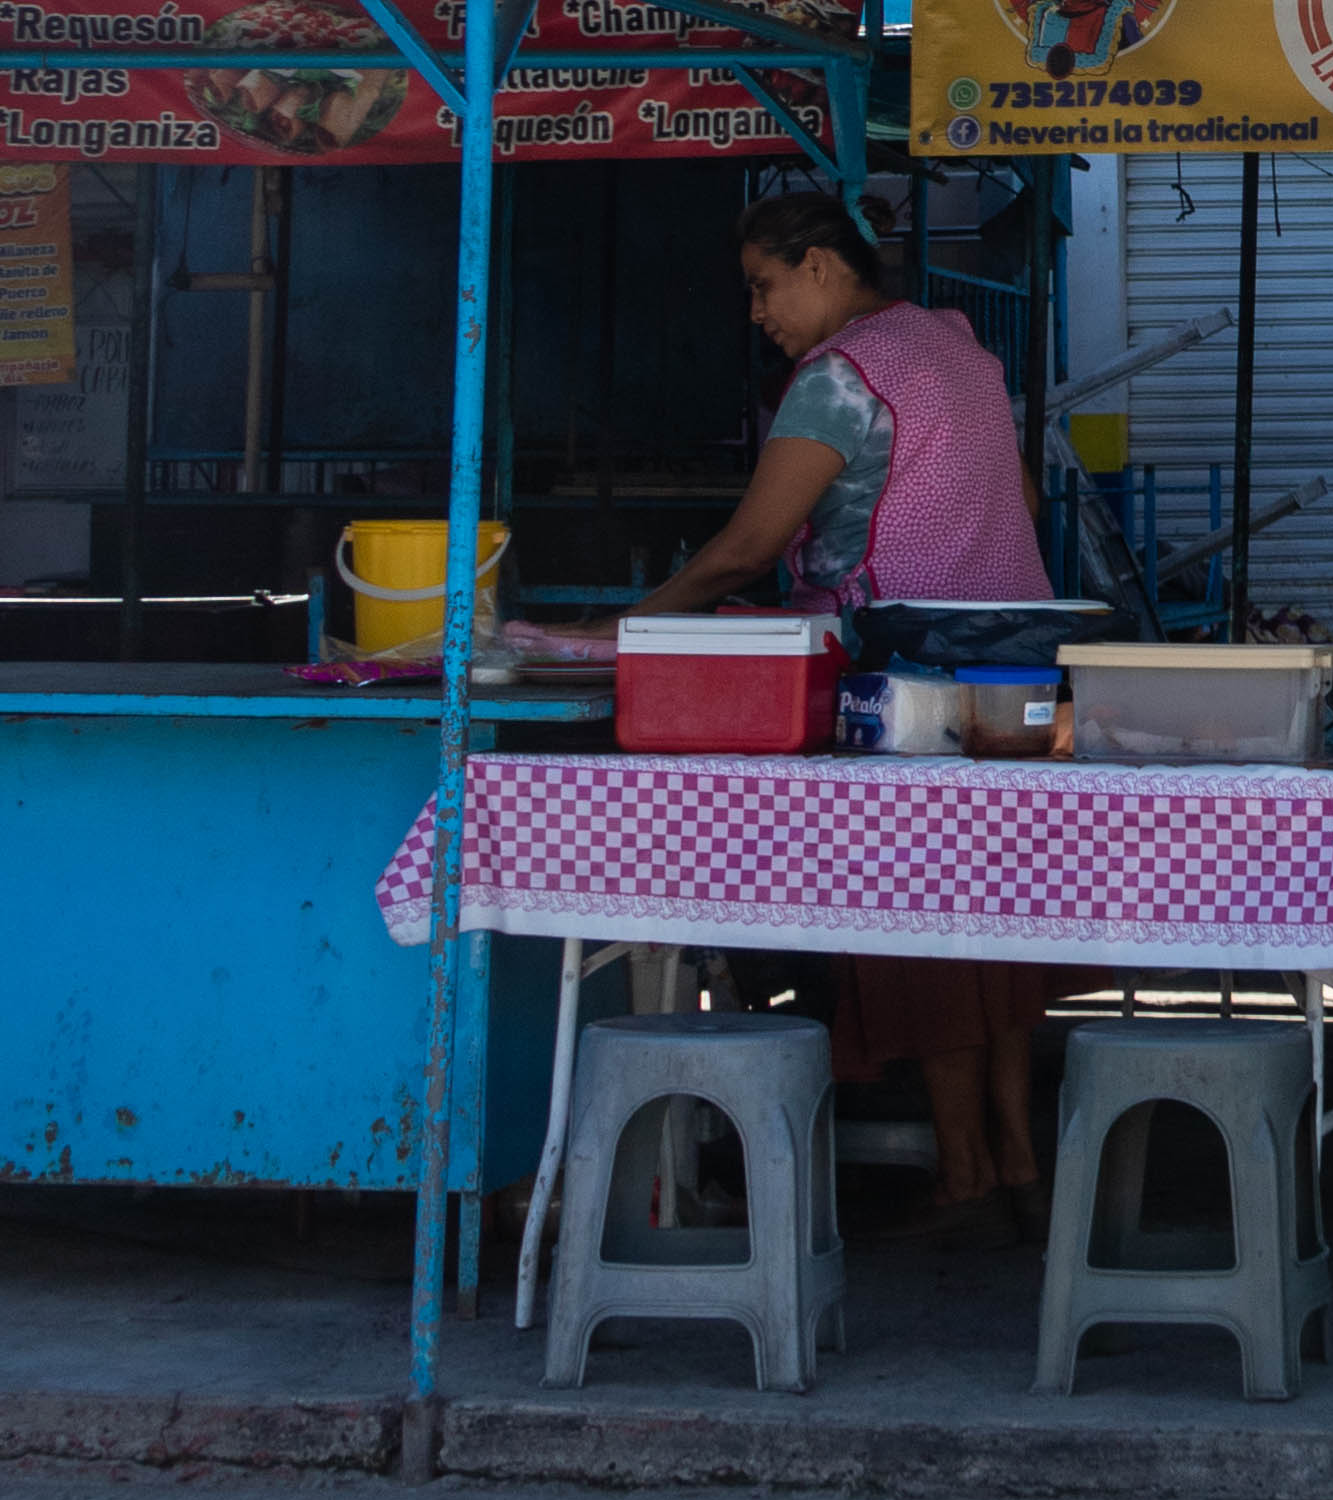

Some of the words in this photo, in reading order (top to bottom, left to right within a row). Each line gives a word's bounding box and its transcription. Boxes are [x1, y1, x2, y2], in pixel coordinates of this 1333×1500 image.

[989, 80, 1202, 108] 7352174039
[989, 117, 1111, 145] Neveria
[1113, 118, 1142, 143] la
[1147, 116, 1319, 143] tradicional
